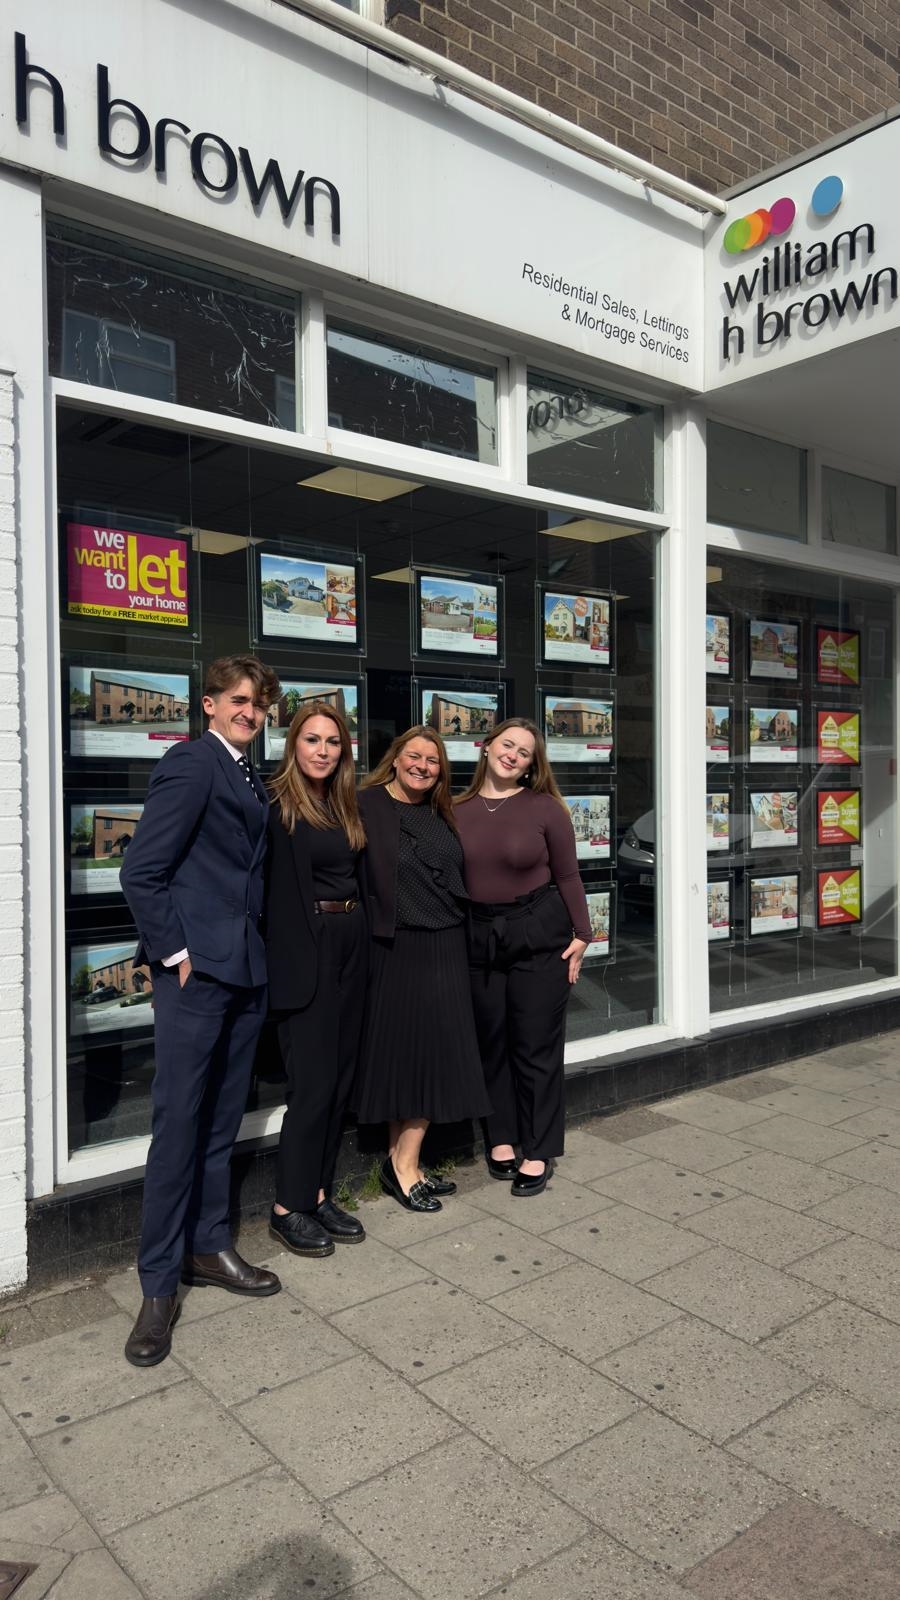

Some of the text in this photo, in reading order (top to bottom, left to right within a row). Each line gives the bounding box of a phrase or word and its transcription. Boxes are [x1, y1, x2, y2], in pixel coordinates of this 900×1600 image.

[14, 31, 340, 235] h brown
[723, 223, 875, 309] william
[522, 263, 689, 341] Residential Sales, Lettings
[723, 267, 898, 360] h brown
[561, 303, 689, 363] & Mortgage Services
[75, 547, 126, 570] want
[94, 530, 125, 549] we
[127, 535, 186, 598] let
[104, 568, 126, 590] to
[128, 595, 187, 611] your home
[82, 606, 102, 616] today
[102, 608, 112, 616] for
[118, 611, 137, 619] FREE
[138, 613, 160, 621] market
[160, 615, 187, 625] appraisal
